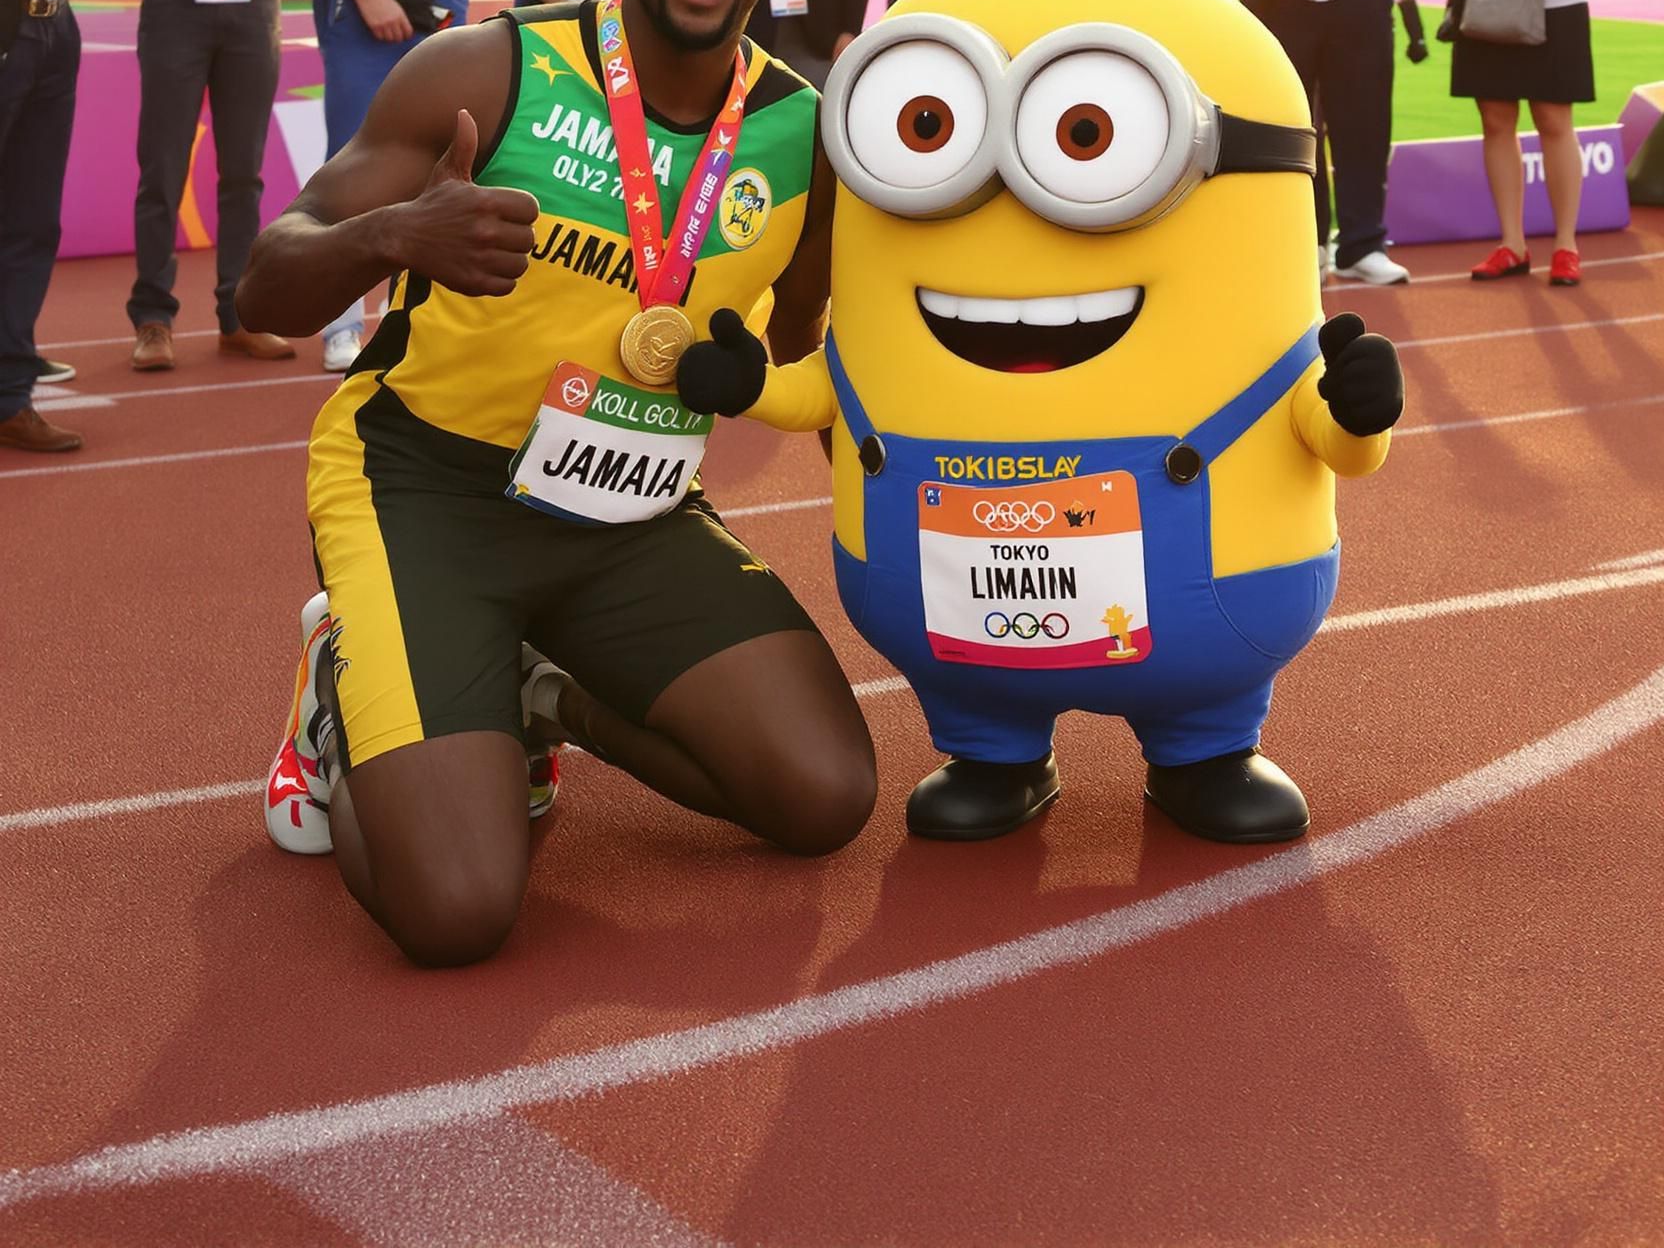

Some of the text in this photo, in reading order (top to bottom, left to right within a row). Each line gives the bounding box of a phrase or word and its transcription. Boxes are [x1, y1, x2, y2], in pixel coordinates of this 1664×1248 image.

[591, 389, 639, 422] KOLL
[542, 439, 686, 498] JAMAIA
[934, 455, 1082, 480] TOKIBSLAY
[990, 545, 1049, 560] TOKYO
